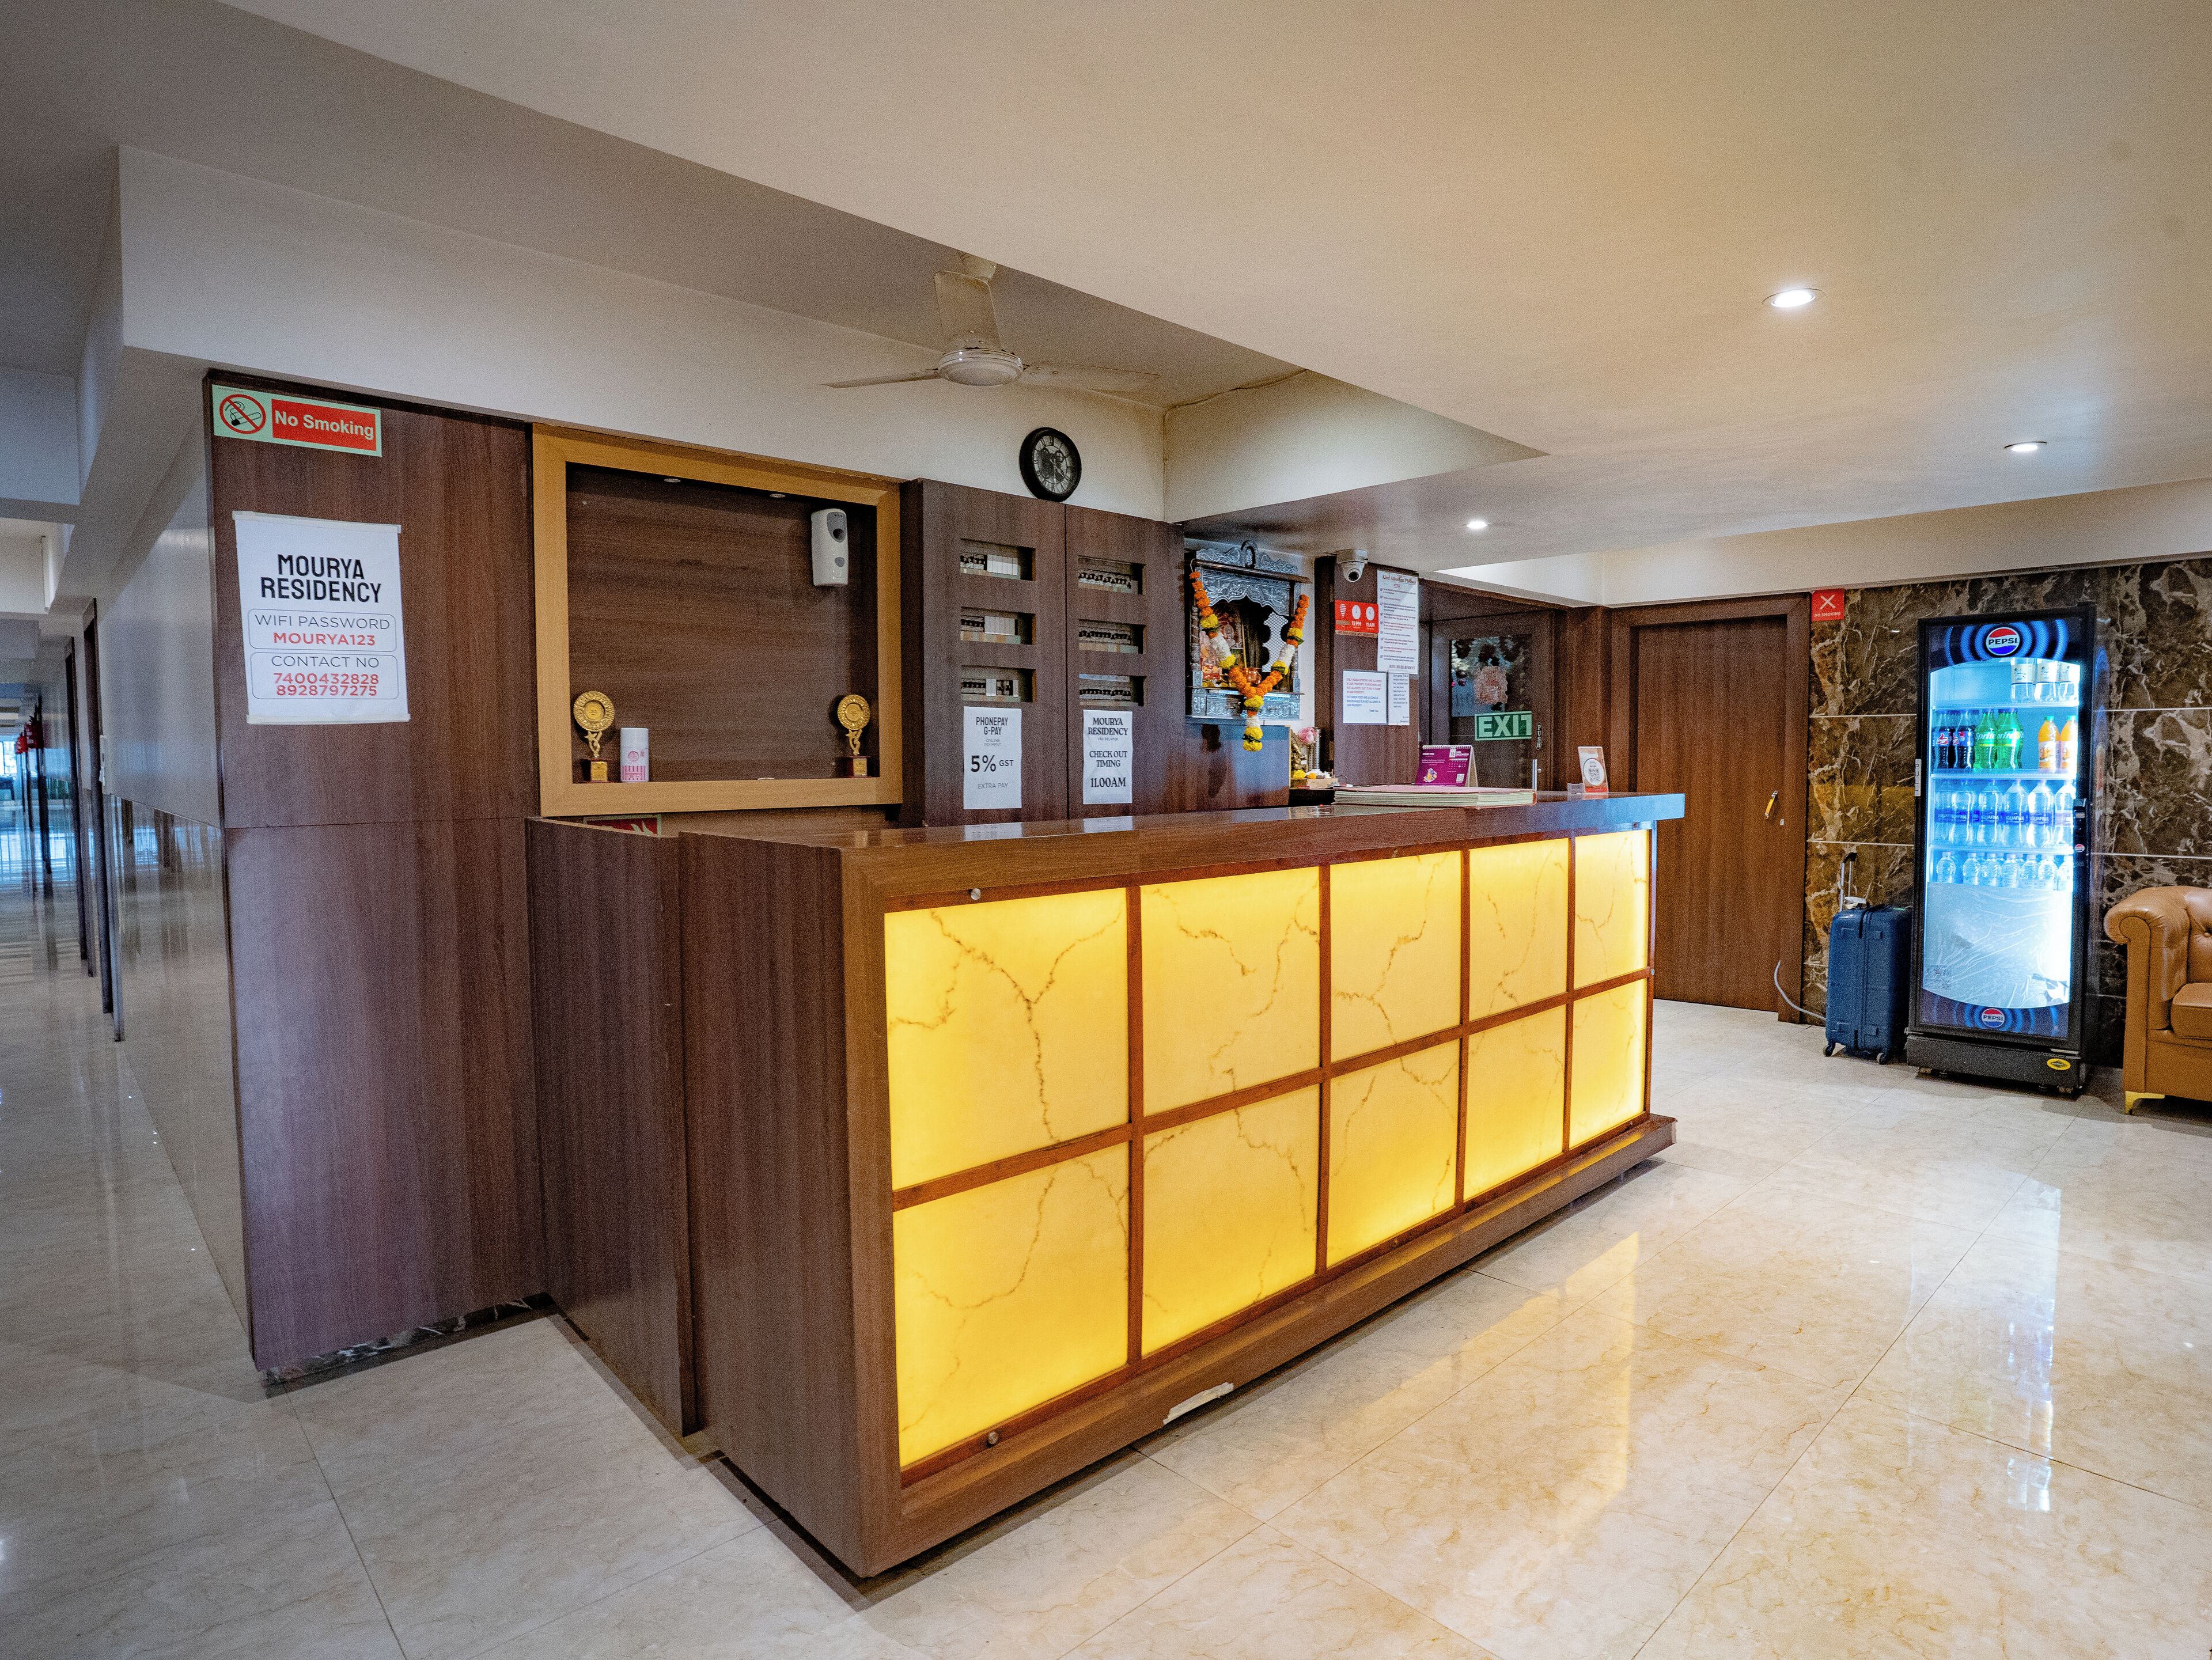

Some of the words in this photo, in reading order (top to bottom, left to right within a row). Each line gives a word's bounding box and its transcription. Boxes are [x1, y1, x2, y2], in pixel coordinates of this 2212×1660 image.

[275, 410, 298, 427] No
[304, 414, 374, 440] Smoking
[278, 554, 365, 579] MOURYA
[261, 577, 381, 603] RESIDENCY
[255, 614, 292, 626] WIFI
[299, 616, 390, 630] PASSWORD
[273, 632, 375, 646] MOURYA123
[271, 655, 350, 668] CONTACT
[356, 657, 379, 668] NO
[273, 673, 379, 684] 7400432828
[276, 685, 377, 696] 8928797275
[976, 717, 1008, 726] PHONEPAY
[1093, 717, 1123, 725] MOURYA
[1479, 714, 1532, 737] EXIT
[984, 726, 1002, 735] G-PAY
[1088, 727, 1128, 735] RESIDENCY
[971, 755, 996, 772] 5%
[1090, 777, 1126, 787] 11.00AM
